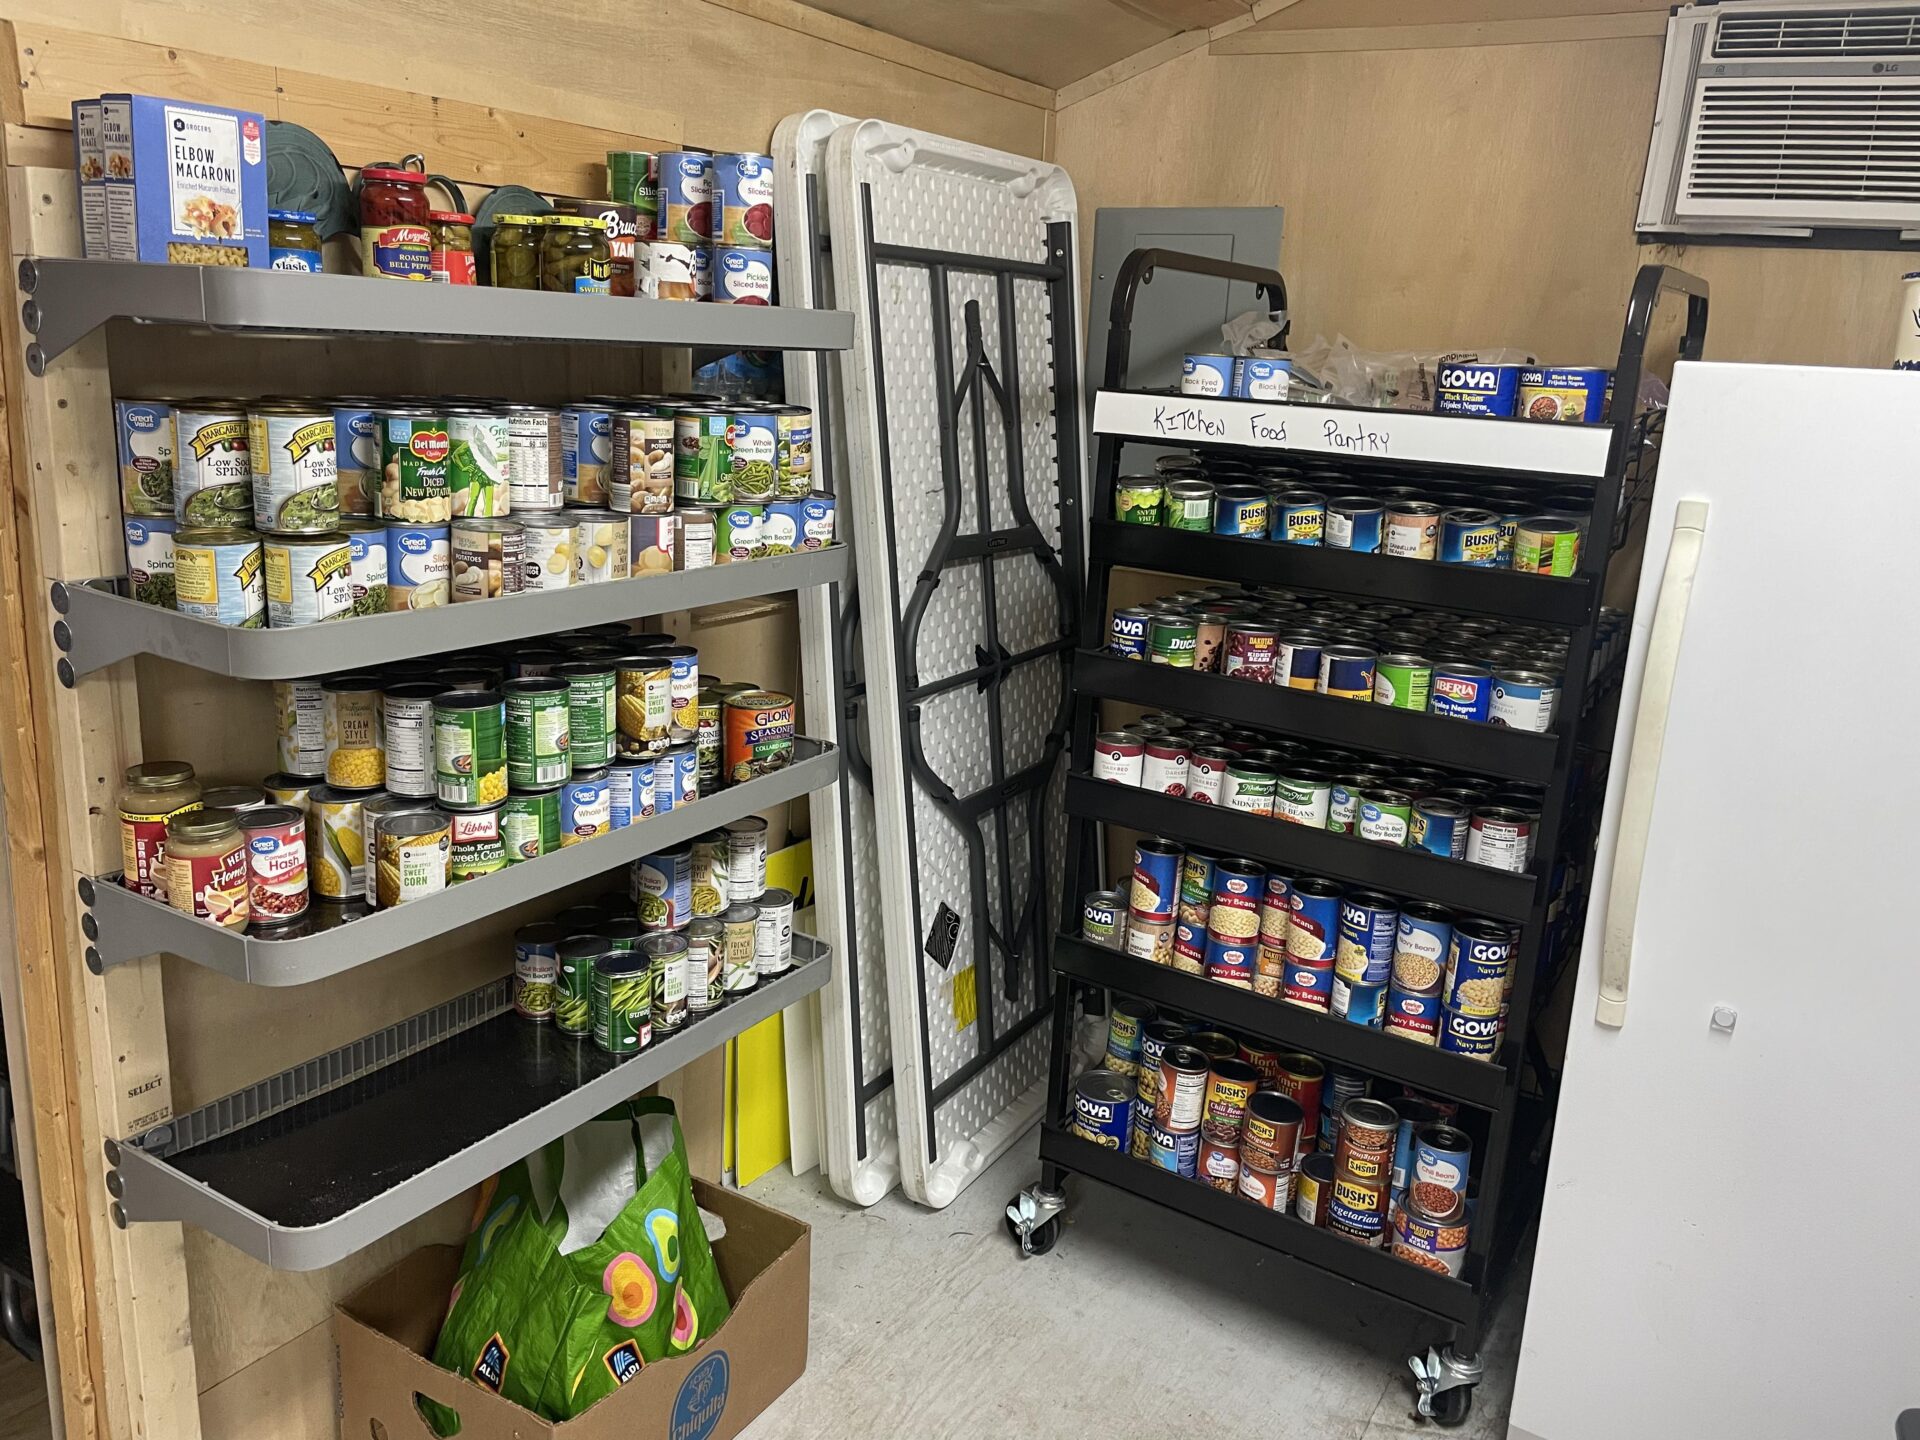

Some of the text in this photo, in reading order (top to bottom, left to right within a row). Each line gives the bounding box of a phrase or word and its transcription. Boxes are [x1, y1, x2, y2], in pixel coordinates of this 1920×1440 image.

[1885, 63, 1899, 72] LG
[104, 122, 120, 133] ELBOW
[186, 124, 211, 133] GROCERS
[104, 133, 130, 143] MACARONI
[175, 145, 214, 163] ELBOW
[176, 163, 236, 182] MACARONI
[682, 162, 701, 173] Great
[740, 163, 758, 172] Great
[177, 181, 236, 194] Enriched Product
[691, 186, 710, 194] Sliced
[748, 187, 766, 196] Sliced
[400, 254, 429, 262] ROASTED
[726, 257, 745, 266] Great
[747, 273, 768, 281] Pickled
[1252, 366, 1270, 374] Great
[1441, 369, 1497, 389] GOYA
[1521, 372, 1542, 383] GOYA
[1258, 383, 1276, 391] Black
[1444, 393, 1484, 403] Black Beans
[1440, 400, 1487, 412] Frijoles Negros
[129, 413, 154, 424] Great
[1250, 413, 1287, 441] Food
[202, 425, 241, 442] MARGARET
[414, 440, 428, 449] Del
[753, 439, 772, 447] Whole
[208, 457, 231, 467] Low
[304, 459, 327, 469] Low
[807, 506, 824, 515] Great
[732, 513, 750, 522] Great
[1288, 513, 1324, 527] BUSH'S
[782, 527, 793, 535] Cut
[808, 528, 823, 536] Green
[402, 538, 426, 547] Great
[1464, 533, 1499, 547] BUSH'S
[327, 585, 346, 595] Low
[1436, 679, 1474, 696] IBERIA
[1451, 704, 1477, 713] Negros
[755, 709, 792, 726] GLORY
[343, 720, 369, 729] CREAM
[345, 730, 367, 739] STYLE
[574, 791, 595, 800] Great
[1232, 799, 1262, 809] KIDNEY
[578, 809, 601, 818] Whole
[1288, 808, 1314, 817] BEANS
[1333, 810, 1350, 818] Kidney
[1362, 807, 1377, 815] Great
[460, 820, 493, 835] Libby's
[1362, 827, 1402, 838] Kidney Beans
[253, 840, 274, 848] Great
[477, 841, 501, 850] Kernel
[480, 849, 505, 861] Corn
[269, 856, 300, 871] Hash
[404, 869, 425, 877] SWEET
[404, 876, 428, 887] CORN
[1216, 895, 1256, 908] Navy Beans
[1292, 914, 1314, 930] Beans
[730, 941, 750, 949] FRENCH
[1415, 943, 1436, 952] Beans
[733, 948, 748, 956] STYLE
[1181, 945, 1201, 959] Beans
[1211, 966, 1229, 975] Navy
[1477, 966, 1495, 975] Navy
[1284, 987, 1325, 1002] Navy Beans
[1390, 1015, 1434, 1030] Navy Beans
[1453, 1018, 1498, 1035] GOYA
[1456, 1039, 1475, 1049] Navy
[128, 1078, 162, 1098] SELECT
[1215, 1083, 1246, 1098] BUSH'S
[1210, 1102, 1225, 1111] Chili
[1249, 1120, 1274, 1138] BUSH'S
[1247, 1132, 1274, 1148] Original
[1349, 1150, 1380, 1161] Original
[1349, 1160, 1376, 1173] BUSH'S
[1421, 1166, 1455, 1180] Chili Beans
[1336, 1184, 1376, 1206] BUSH'S
[1347, 1200, 1360, 1208] BEST
[1331, 1202, 1379, 1224] Vegetarian
[1409, 1239, 1431, 1250] BEANS
[478, 1363, 499, 1385] ALDI
[621, 1363, 640, 1382] ALDI
